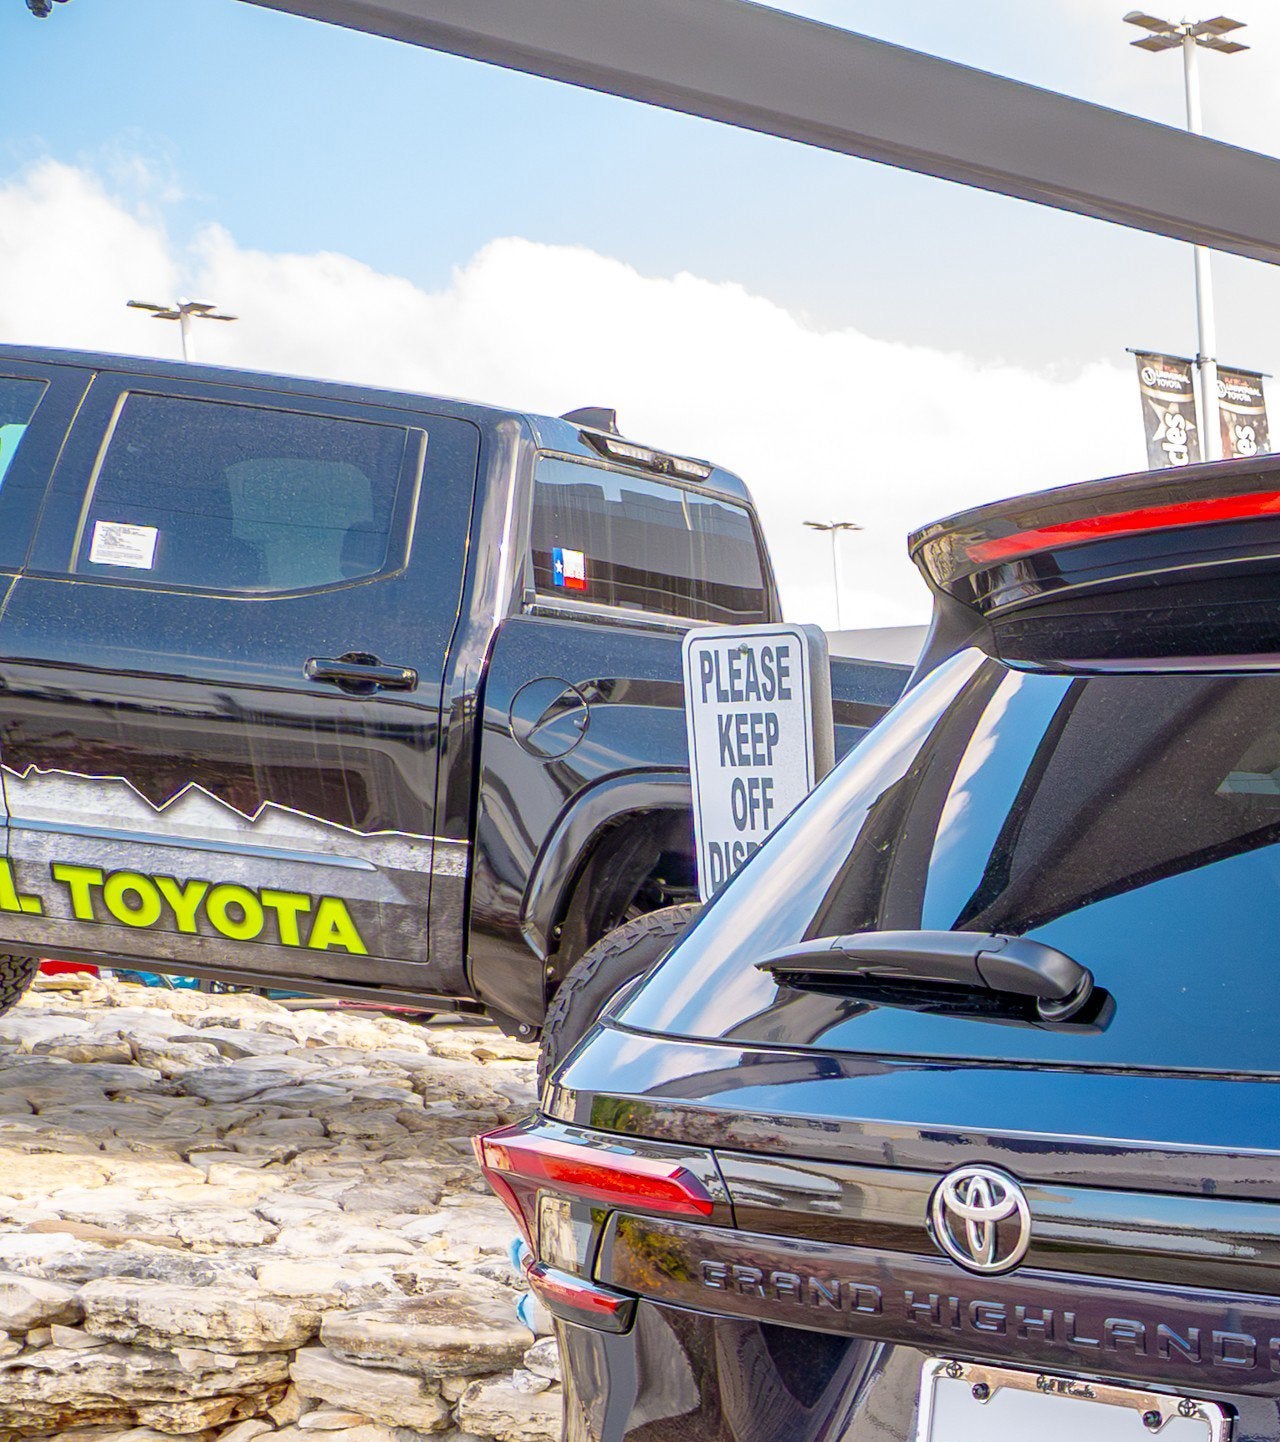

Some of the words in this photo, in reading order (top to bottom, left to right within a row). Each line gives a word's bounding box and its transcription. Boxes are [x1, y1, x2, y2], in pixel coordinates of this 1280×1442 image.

[699, 645, 793, 703] PLEASE
[717, 712, 780, 767] KEEP
[731, 776, 774, 832] OFF
[52, 863, 368, 955] TOYOTA
[699, 1259, 883, 1317] GRAND
